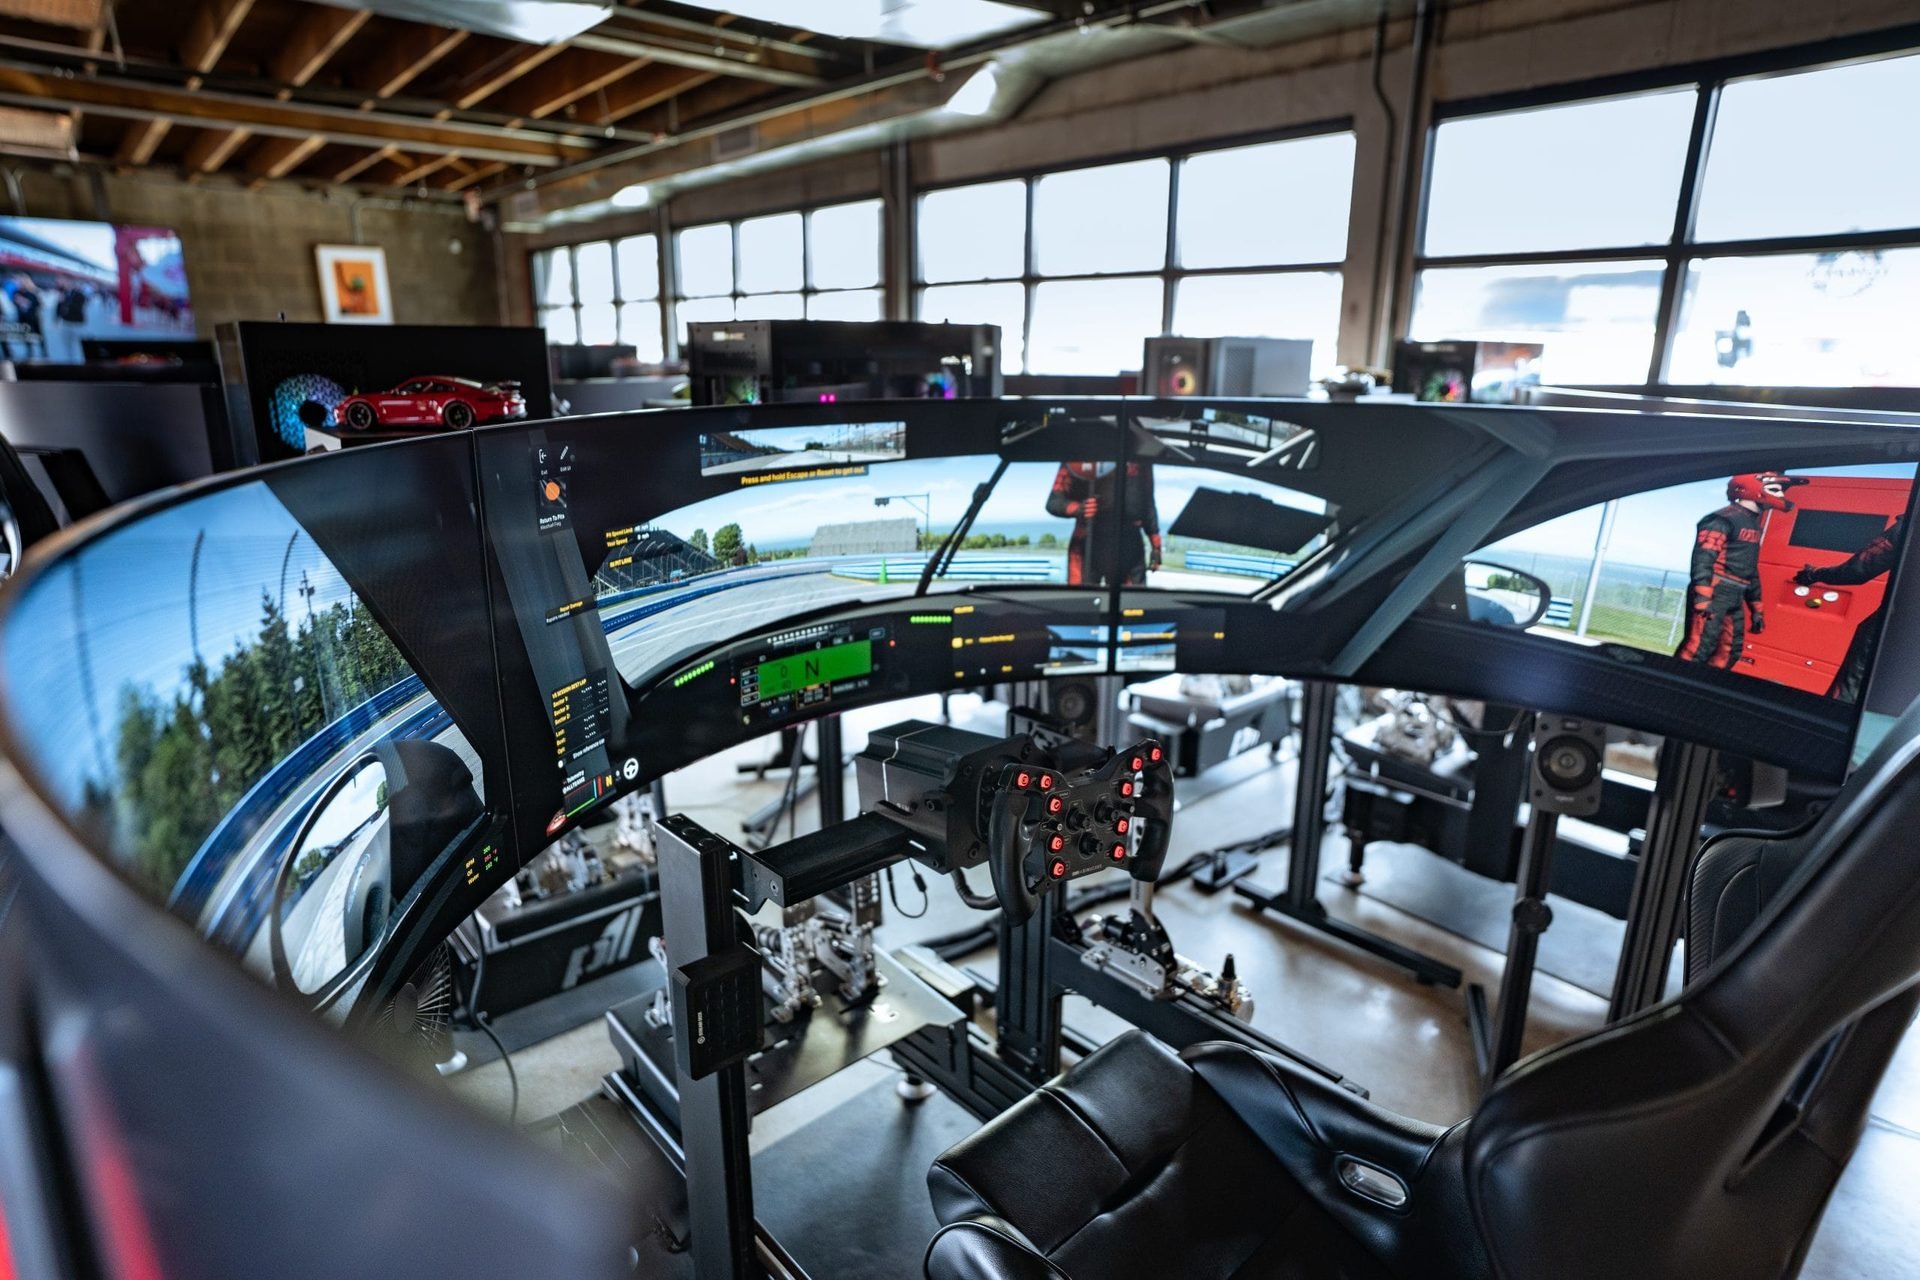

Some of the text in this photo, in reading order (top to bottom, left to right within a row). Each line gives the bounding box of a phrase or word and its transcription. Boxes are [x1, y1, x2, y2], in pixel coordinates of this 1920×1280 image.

[741, 476, 759, 485] Press
[760, 474, 771, 482] and
[772, 472, 785, 481] hold
[787, 471, 808, 480] Escape
[817, 468, 834, 477] Reset
[842, 467, 852, 476] get
[540, 516, 553, 524] Return
[611, 529, 624, 538] Speed
[623, 527, 633, 535] Limit
[615, 537, 628, 546] Speed
[804, 658, 820, 680] N
[605, 774, 613, 788] N
